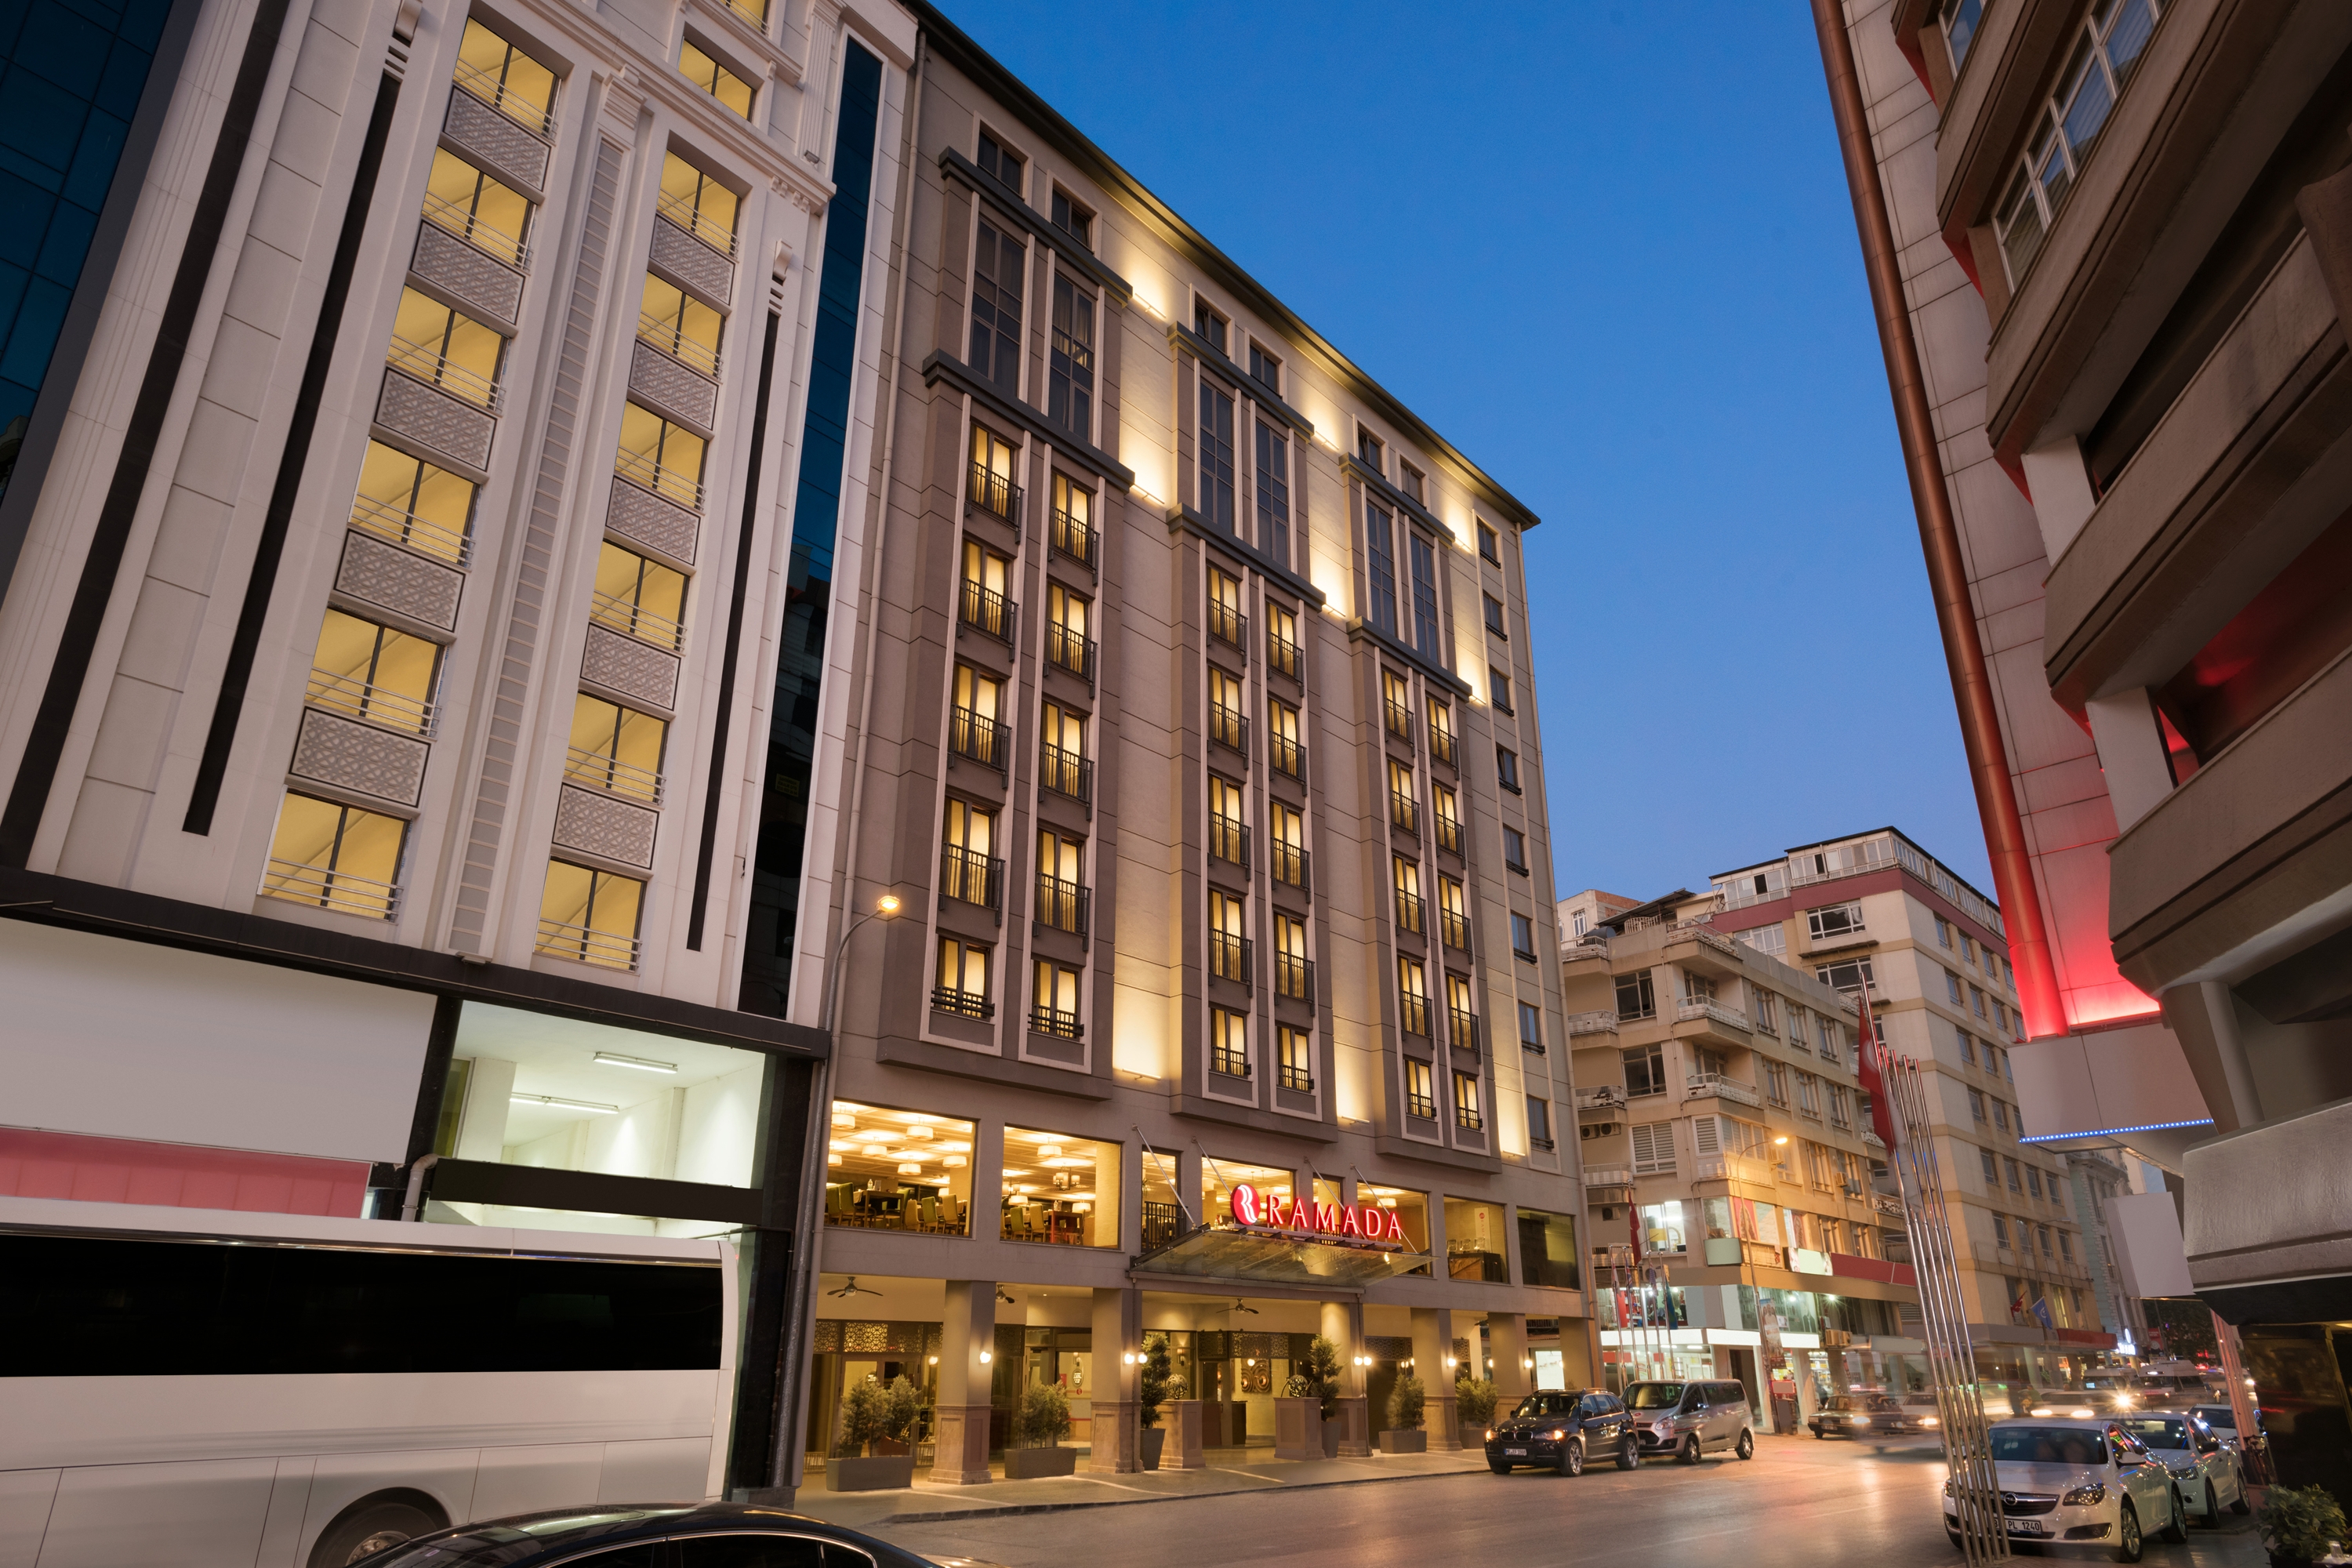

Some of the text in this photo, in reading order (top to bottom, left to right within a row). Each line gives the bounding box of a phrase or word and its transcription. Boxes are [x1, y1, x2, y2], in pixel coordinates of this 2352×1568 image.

[1267, 1194, 1402, 1240] RAMADA
[2008, 1521, 2018, 1530] PL
[2022, 1521, 2040, 1531] 1240
